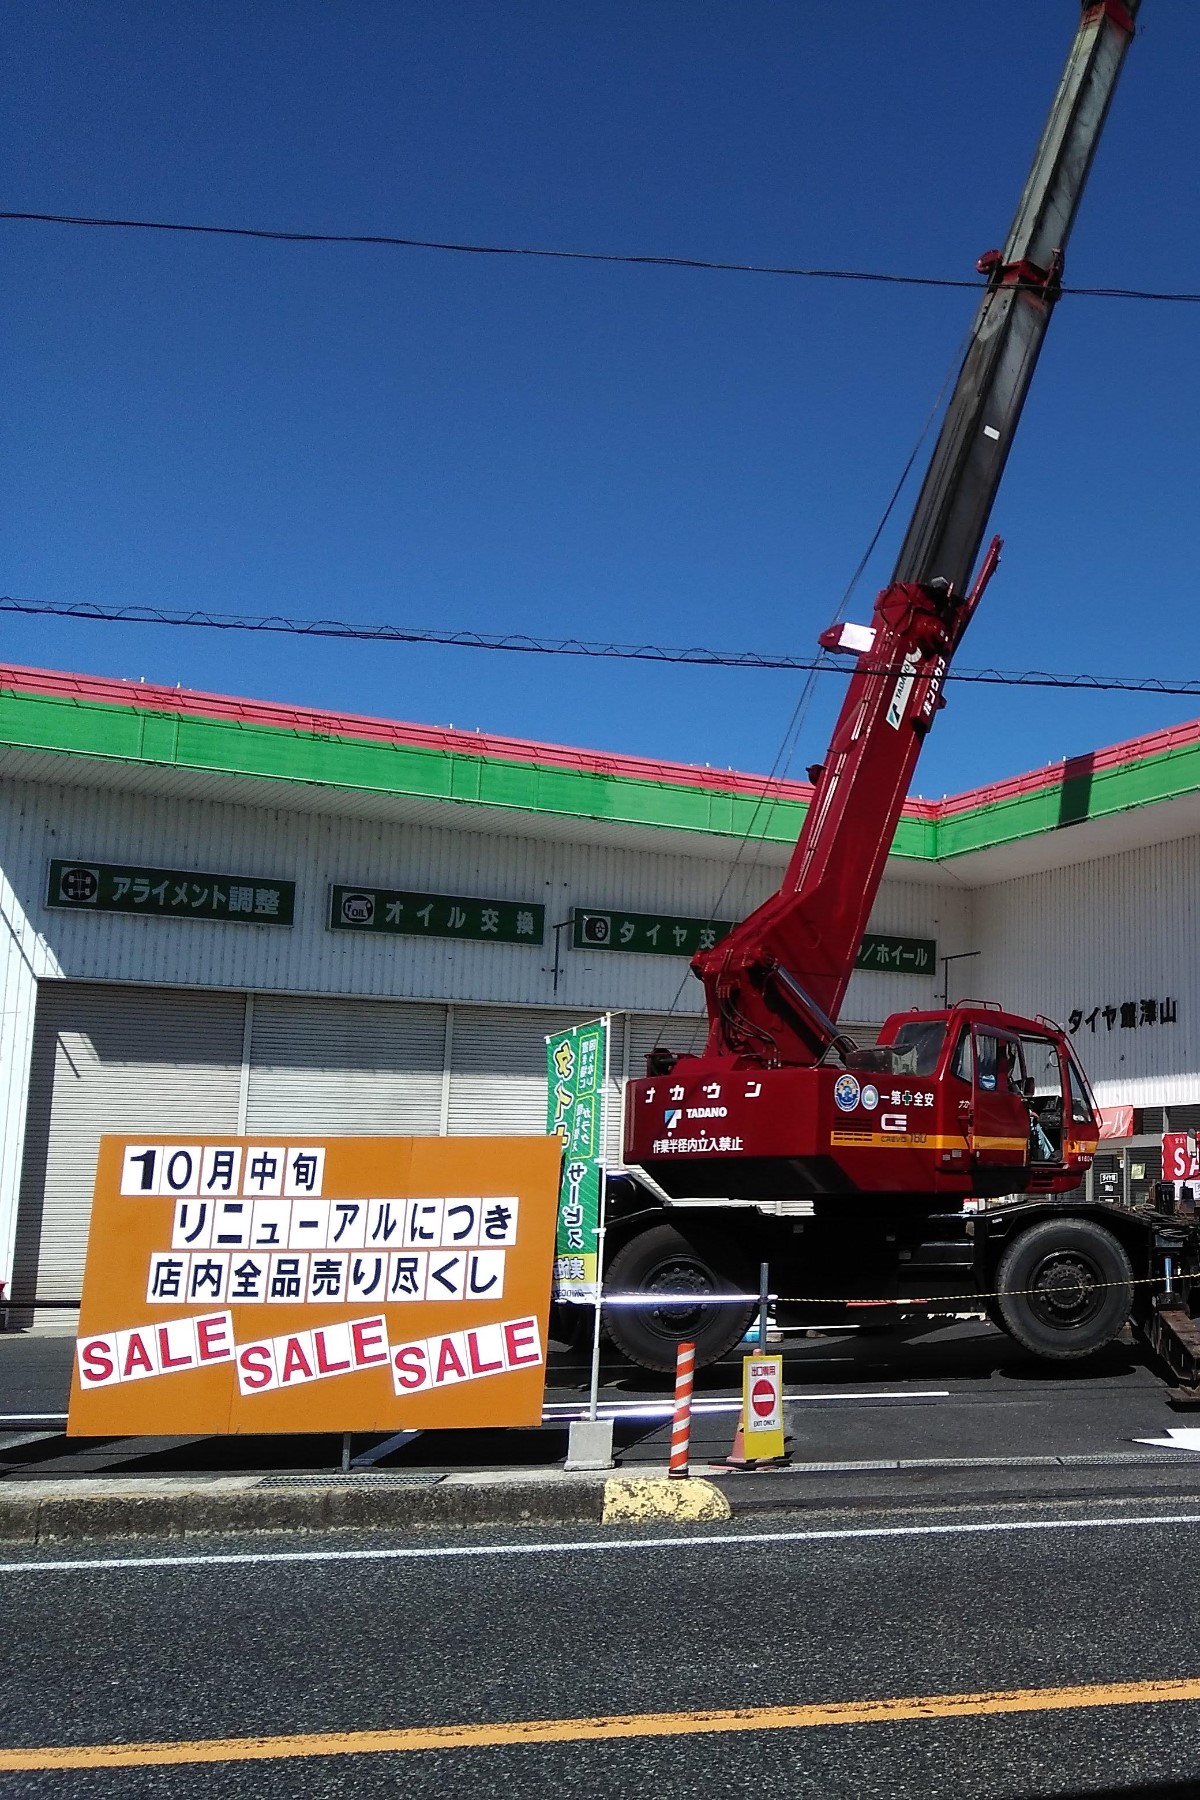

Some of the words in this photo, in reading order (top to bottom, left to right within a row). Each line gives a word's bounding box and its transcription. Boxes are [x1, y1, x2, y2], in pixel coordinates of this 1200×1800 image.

[111, 875, 280, 917] アライメント調整
[350, 908, 367, 918] OIL
[384, 902, 535, 936] オイル交換
[1067, 996, 1177, 1035] タイヤ館津山
[645, 1081, 762, 1103] ナカウン
[686, 1106, 728, 1119] TADANO
[653, 1136, 744, 1154] 作業半径内立入禁止
[129, 1149, 320, 1192] 10月中旬
[178, 1202, 513, 1245] リニューアルにつき
[152, 1257, 499, 1298] 店内全品売り尽くし
[82, 1316, 232, 1382] SALE
[239, 1318, 388, 1388] SALE
[394, 1319, 540, 1388] SALE
